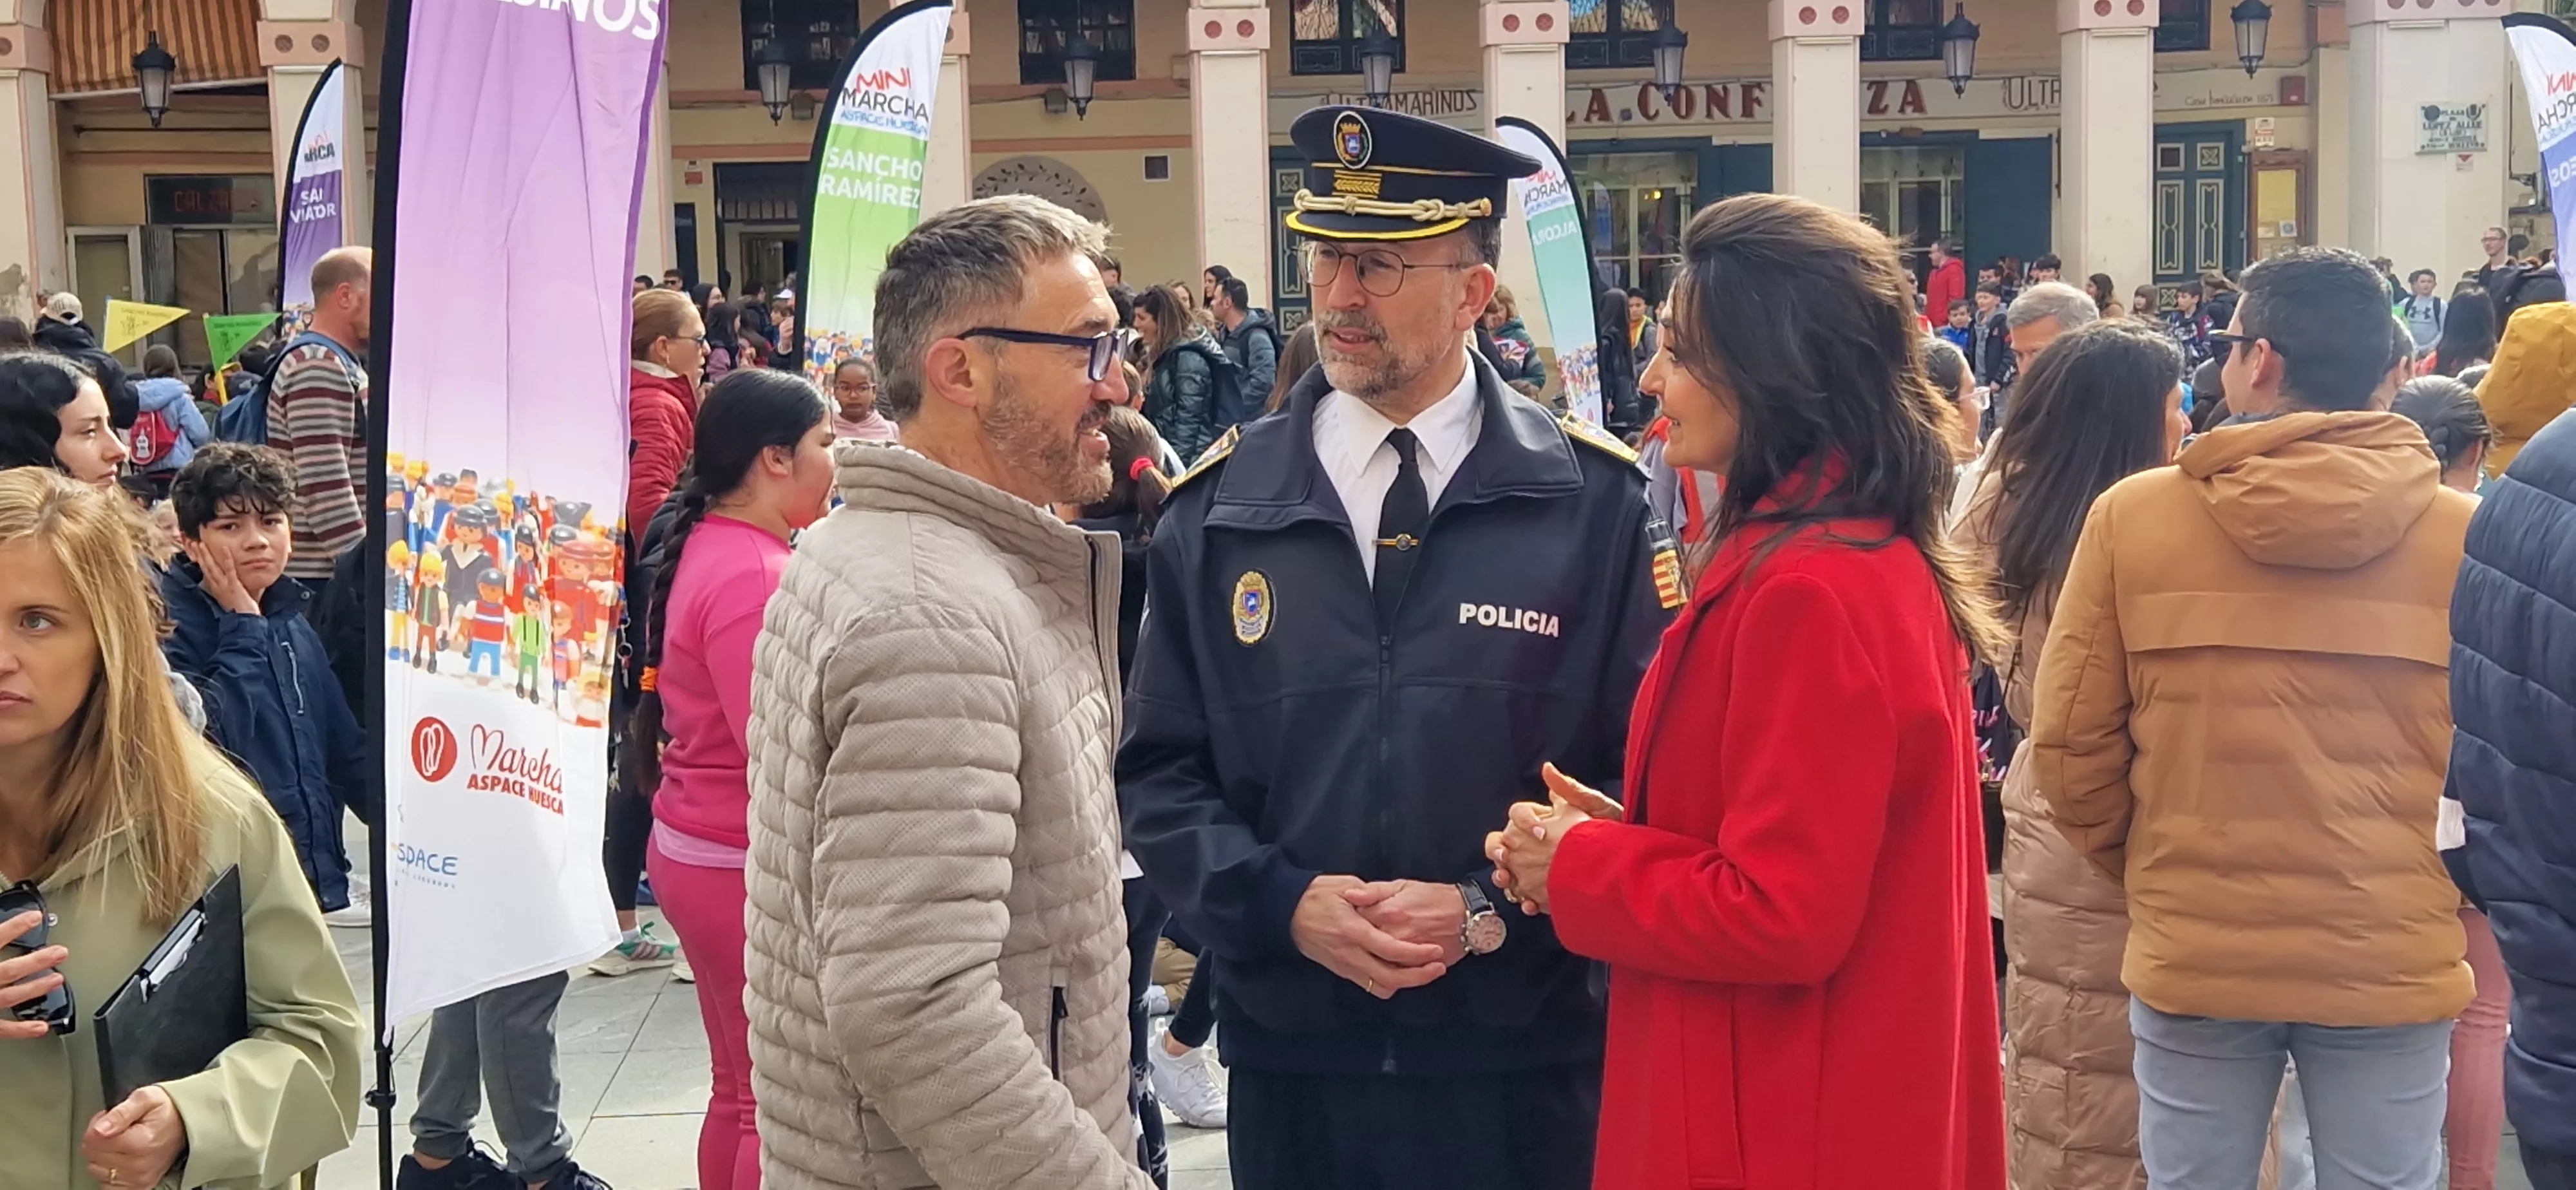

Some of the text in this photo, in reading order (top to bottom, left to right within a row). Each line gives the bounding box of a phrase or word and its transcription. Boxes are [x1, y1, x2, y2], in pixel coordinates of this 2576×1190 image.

[855, 67, 911, 93] MINI
[842, 88, 929, 123] MARCHA
[1566, 88, 1614, 122] A
[827, 147, 923, 182] SANCHO
[820, 174, 921, 209] RAMÍREZ
[1459, 602, 1559, 638] POLICIA
[471, 723, 564, 794] Marcha
[467, 774, 564, 817] ASPACE HUESCA
